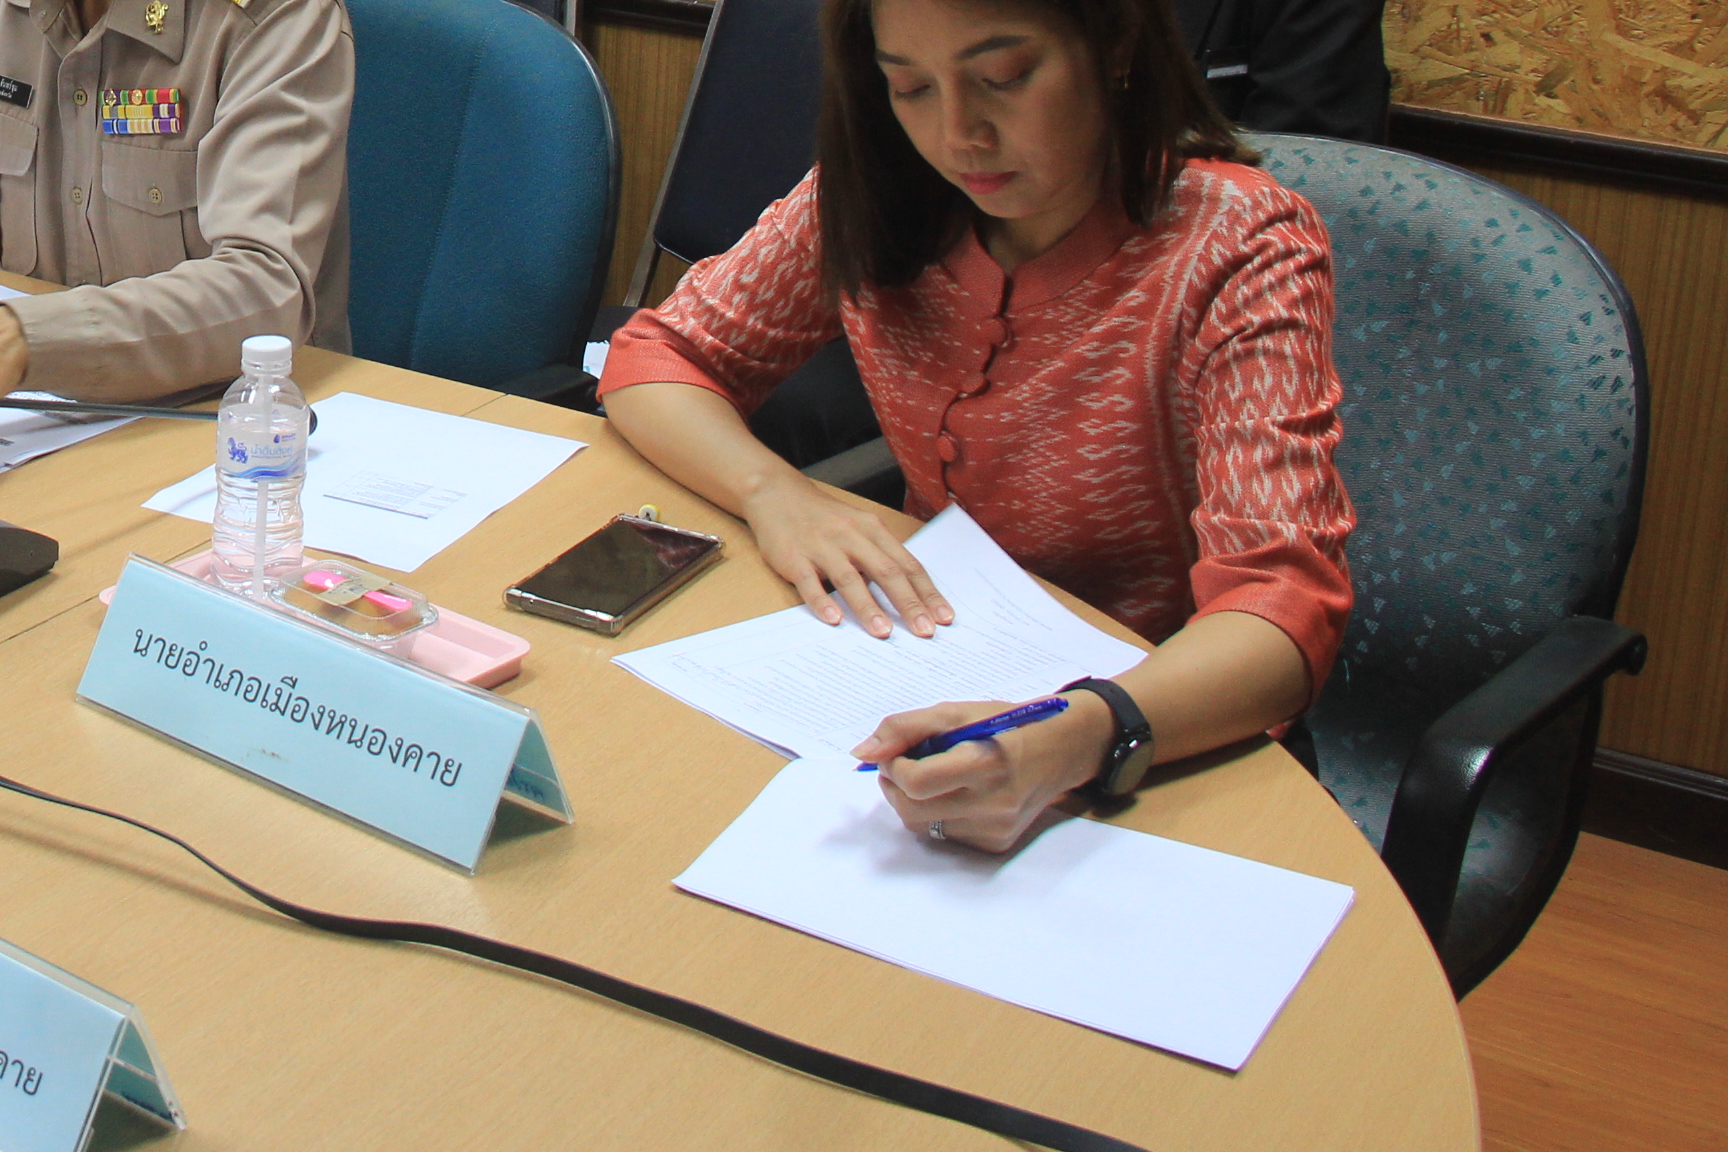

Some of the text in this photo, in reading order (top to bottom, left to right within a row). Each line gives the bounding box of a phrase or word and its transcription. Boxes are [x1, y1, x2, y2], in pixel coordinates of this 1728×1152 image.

[132, 628, 463, 787] นายอำเภอเมืองหนองคาย
